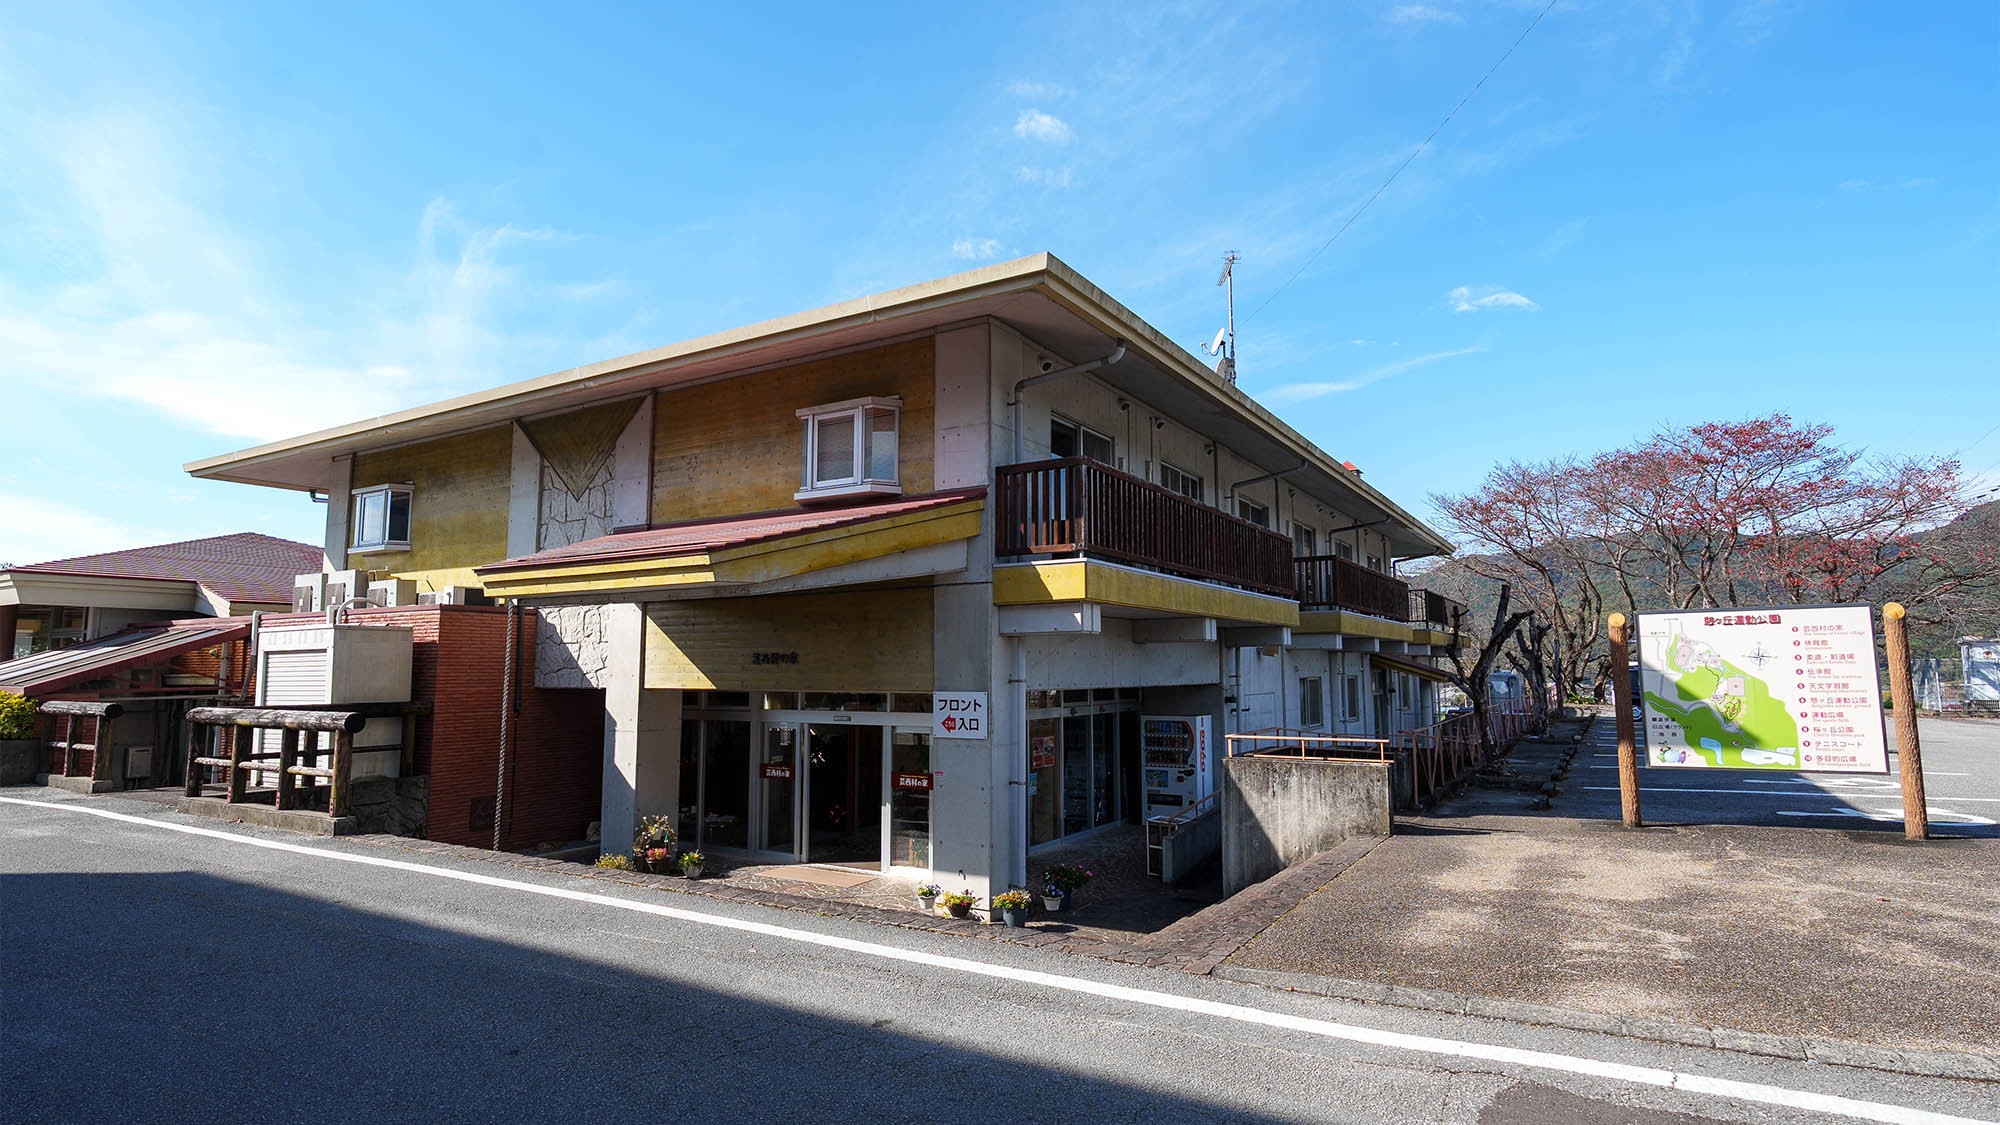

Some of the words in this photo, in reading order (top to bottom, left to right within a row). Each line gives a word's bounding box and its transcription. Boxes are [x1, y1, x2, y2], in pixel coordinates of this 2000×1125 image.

[938, 699, 982, 712] フロント
[958, 717, 979, 731] 入口
